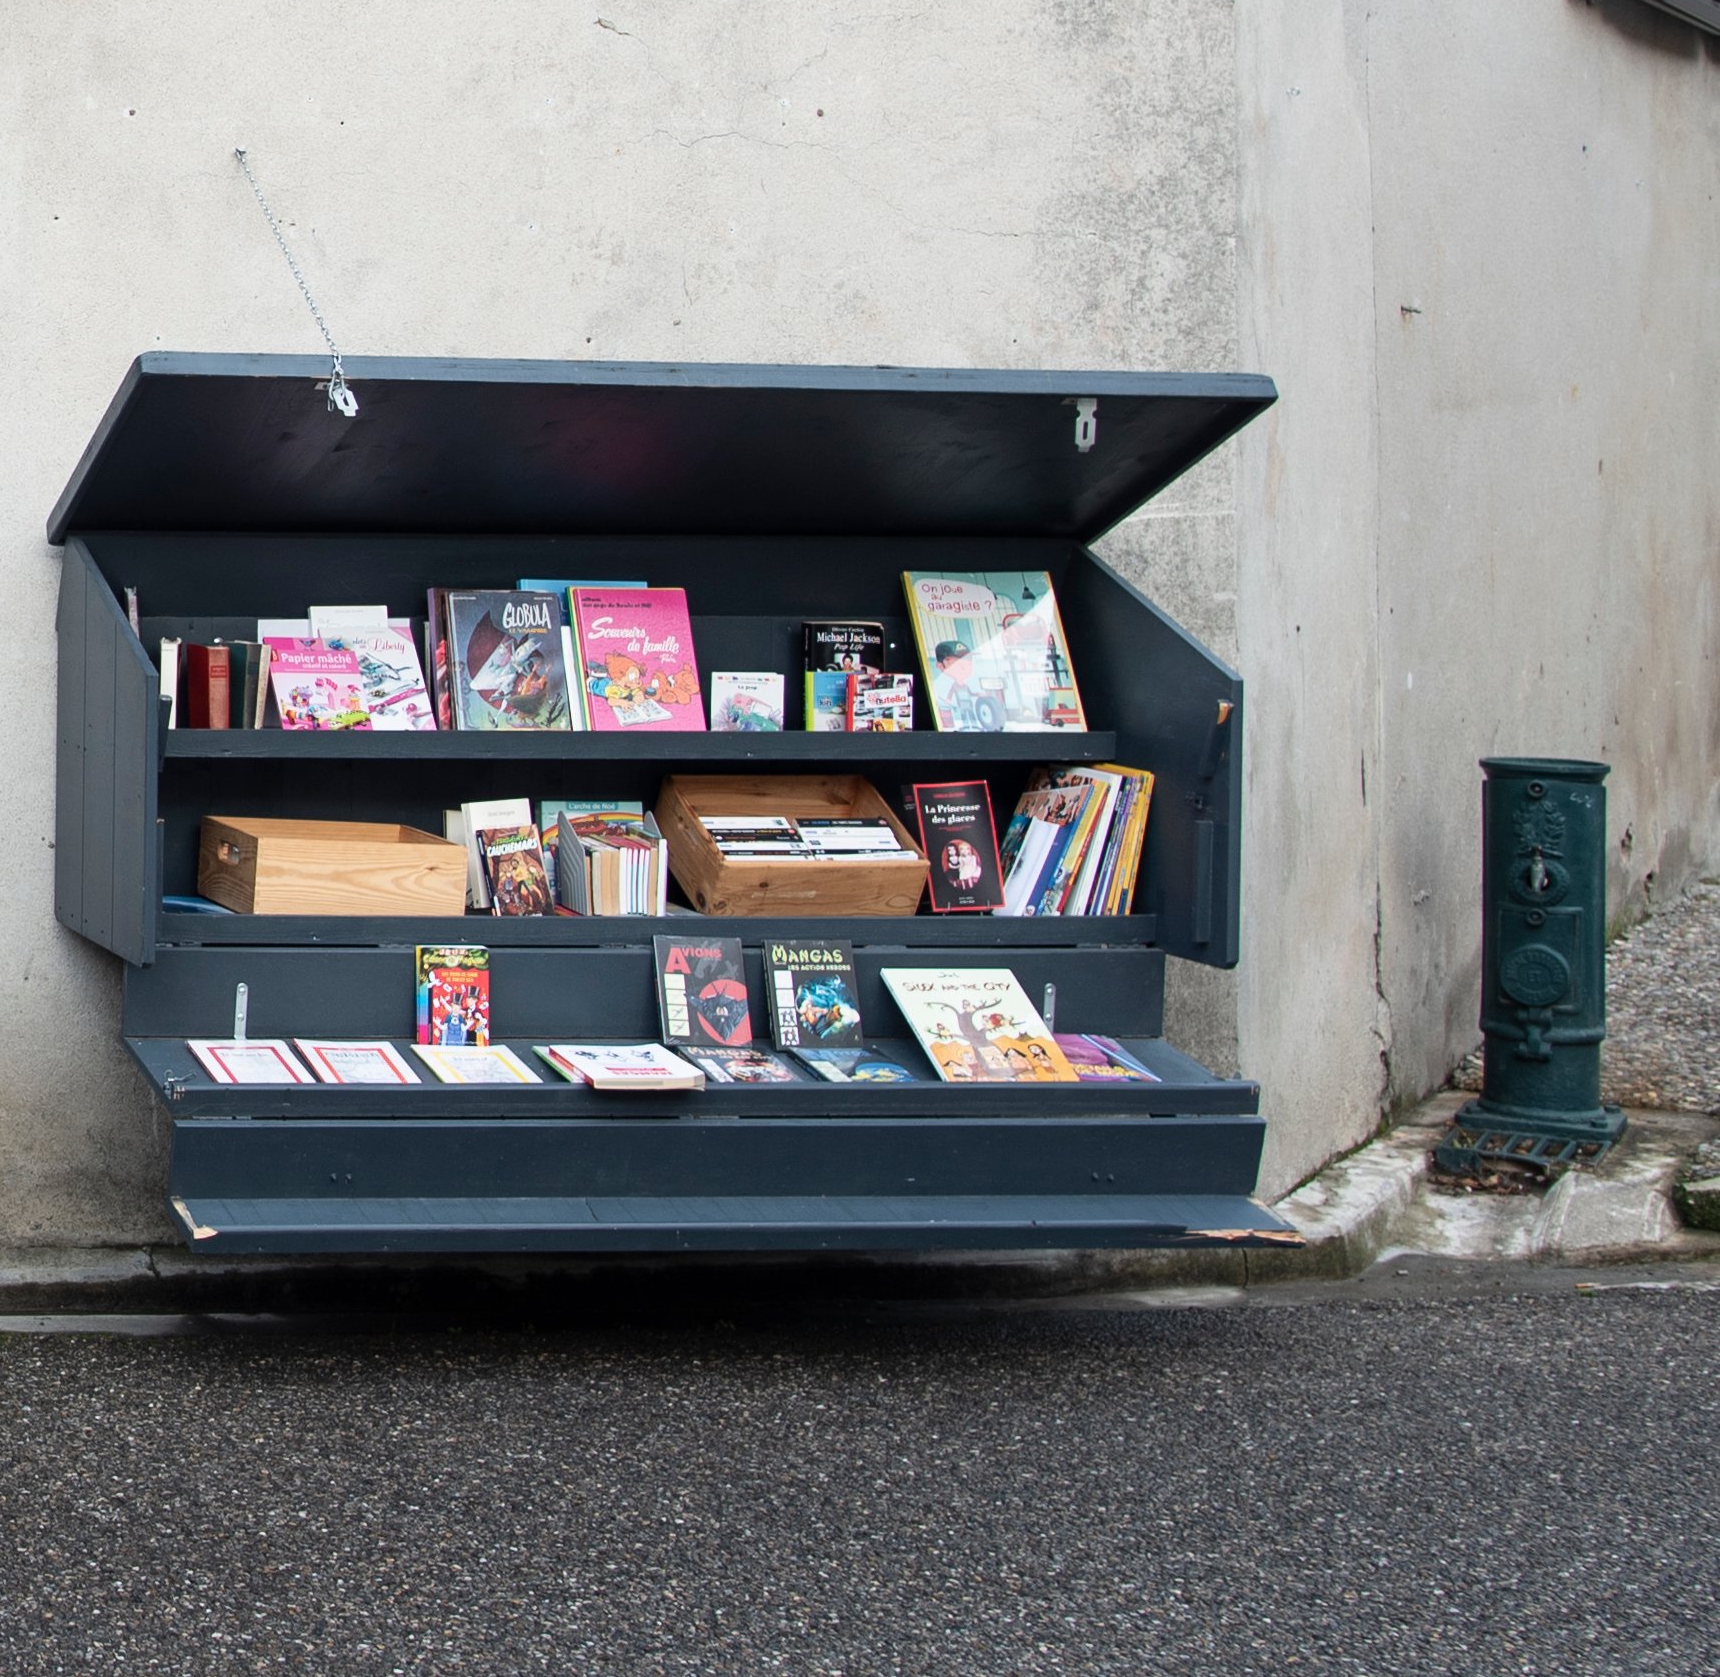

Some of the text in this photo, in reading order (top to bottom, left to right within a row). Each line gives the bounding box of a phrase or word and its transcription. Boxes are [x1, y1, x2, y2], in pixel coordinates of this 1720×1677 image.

[922, 583, 963, 596] On joue
[927, 600, 992, 614] garagiste ?
[502, 601, 552, 630] GLOBULA
[587, 616, 647, 640] Souvenirs
[817, 632, 881, 644] Michael Jackson
[627, 636, 680, 656] de famille
[833, 643, 865, 651] Pop Life
[281, 650, 352, 665] Papier mâché
[925, 803, 981, 814] La Princesse
[932, 813, 977, 825] des glaces
[487, 837, 539, 858] CAUCHEMARS
[664, 947, 722, 974] AVIONS
[771, 944, 844, 966] MANGAS
